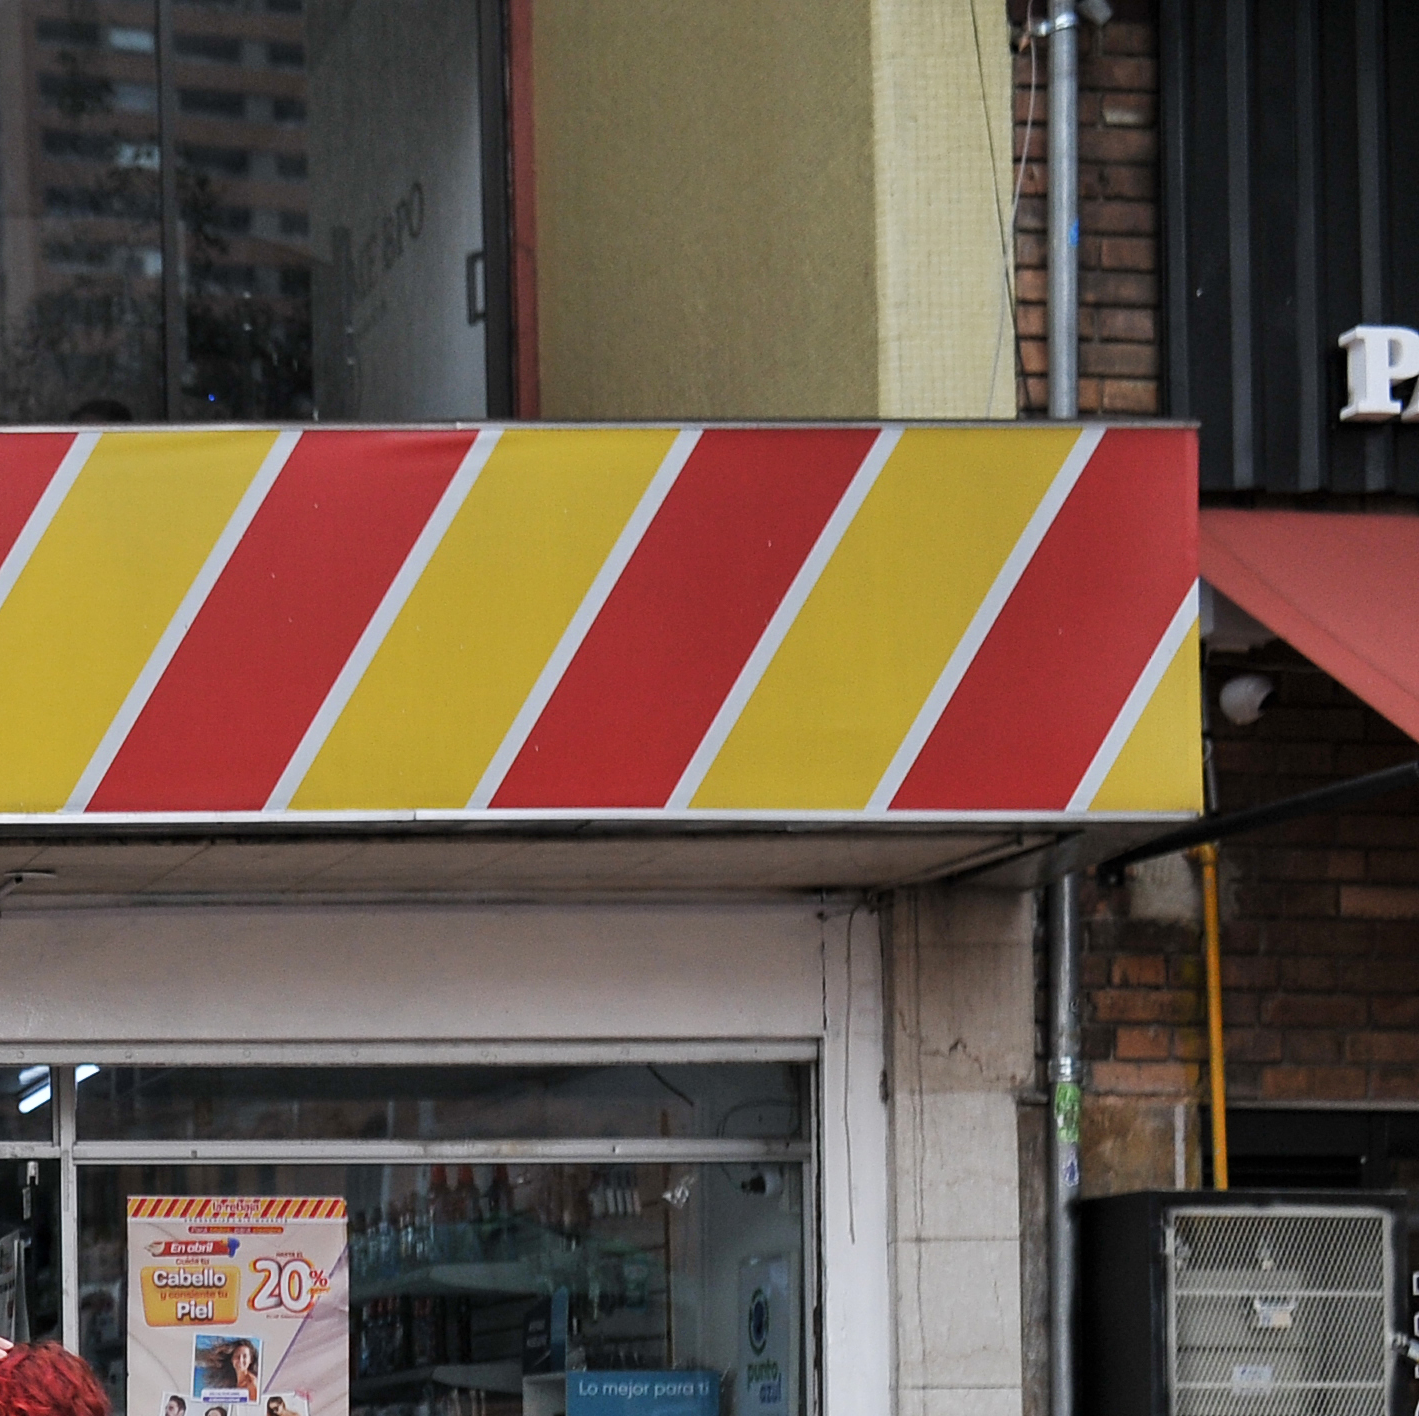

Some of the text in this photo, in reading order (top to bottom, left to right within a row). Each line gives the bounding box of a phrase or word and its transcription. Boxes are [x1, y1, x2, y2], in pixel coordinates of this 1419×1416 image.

[1338, 325, 1419, 421] P
[170, 1242, 214, 1253] En abril
[153, 1270, 226, 1287] Cabello
[176, 1302, 213, 1320] Piel
[579, 1380, 710, 1399] Lo mejor para ti
